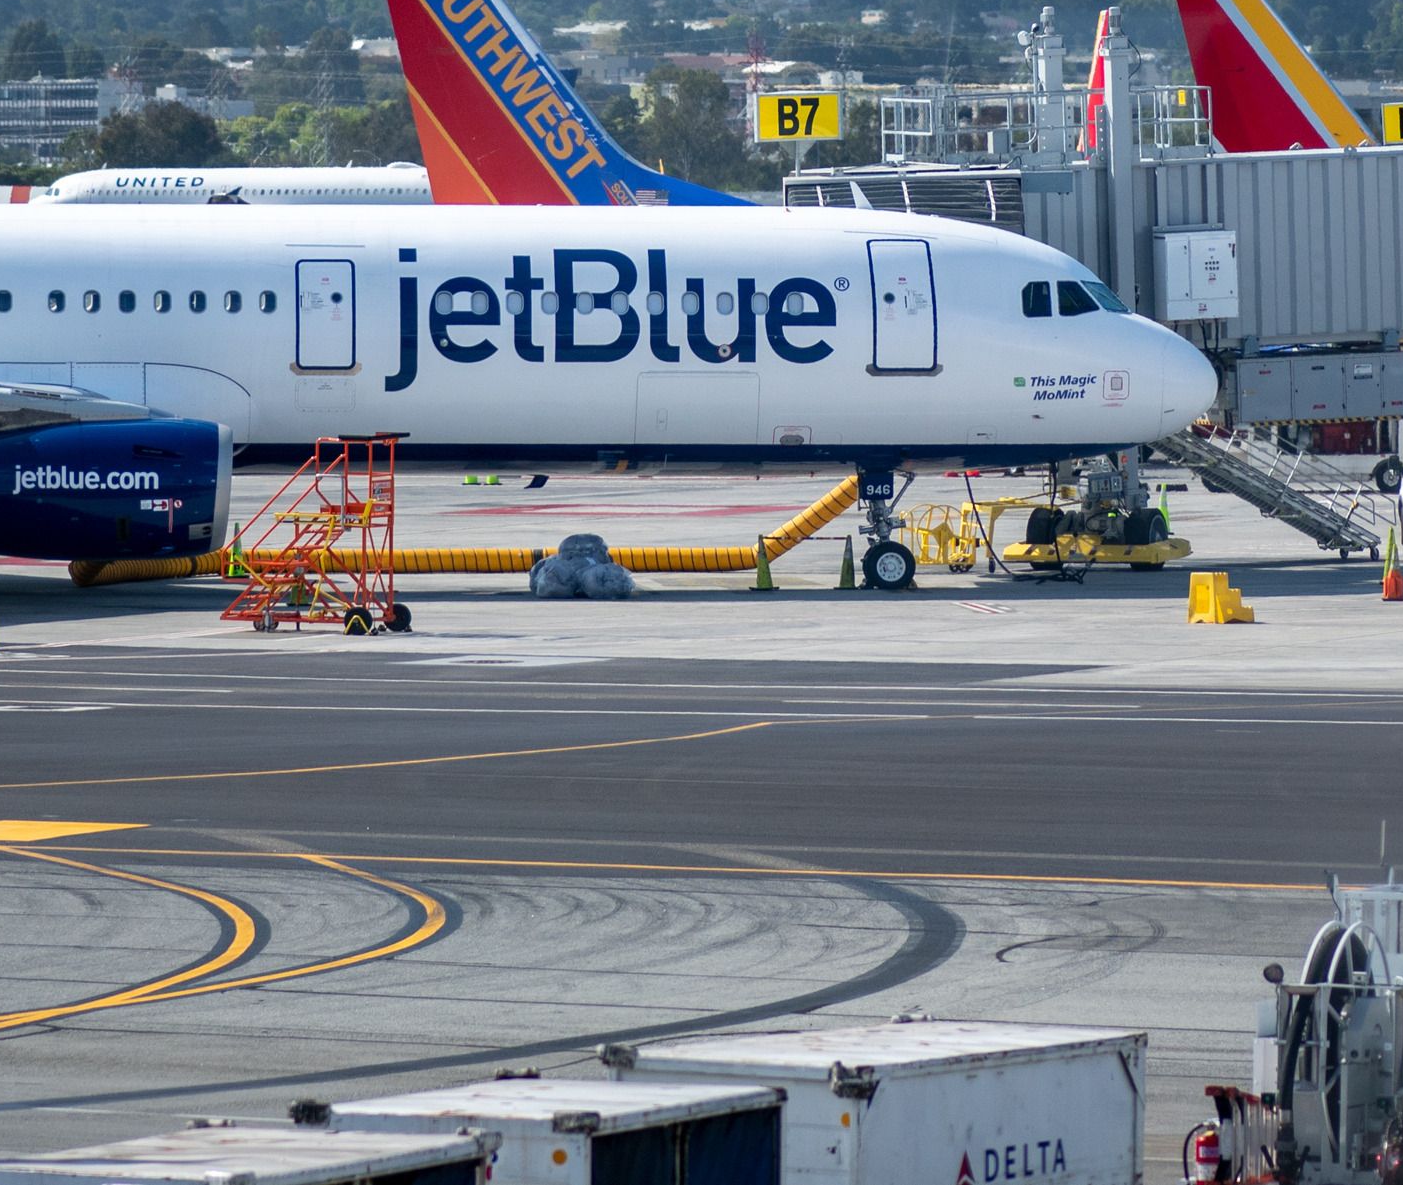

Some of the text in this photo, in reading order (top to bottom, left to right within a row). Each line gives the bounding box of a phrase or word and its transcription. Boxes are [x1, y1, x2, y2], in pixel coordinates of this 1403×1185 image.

[777, 98, 820, 136] B7
[116, 177, 204, 187] UNITED
[1030, 374, 1097, 387] This Magic
[1033, 389, 1086, 401] MoMint
[12, 465, 159, 495] jetblue.com
[866, 484, 891, 495] 946
[985, 1138, 1066, 1182] DELTA
